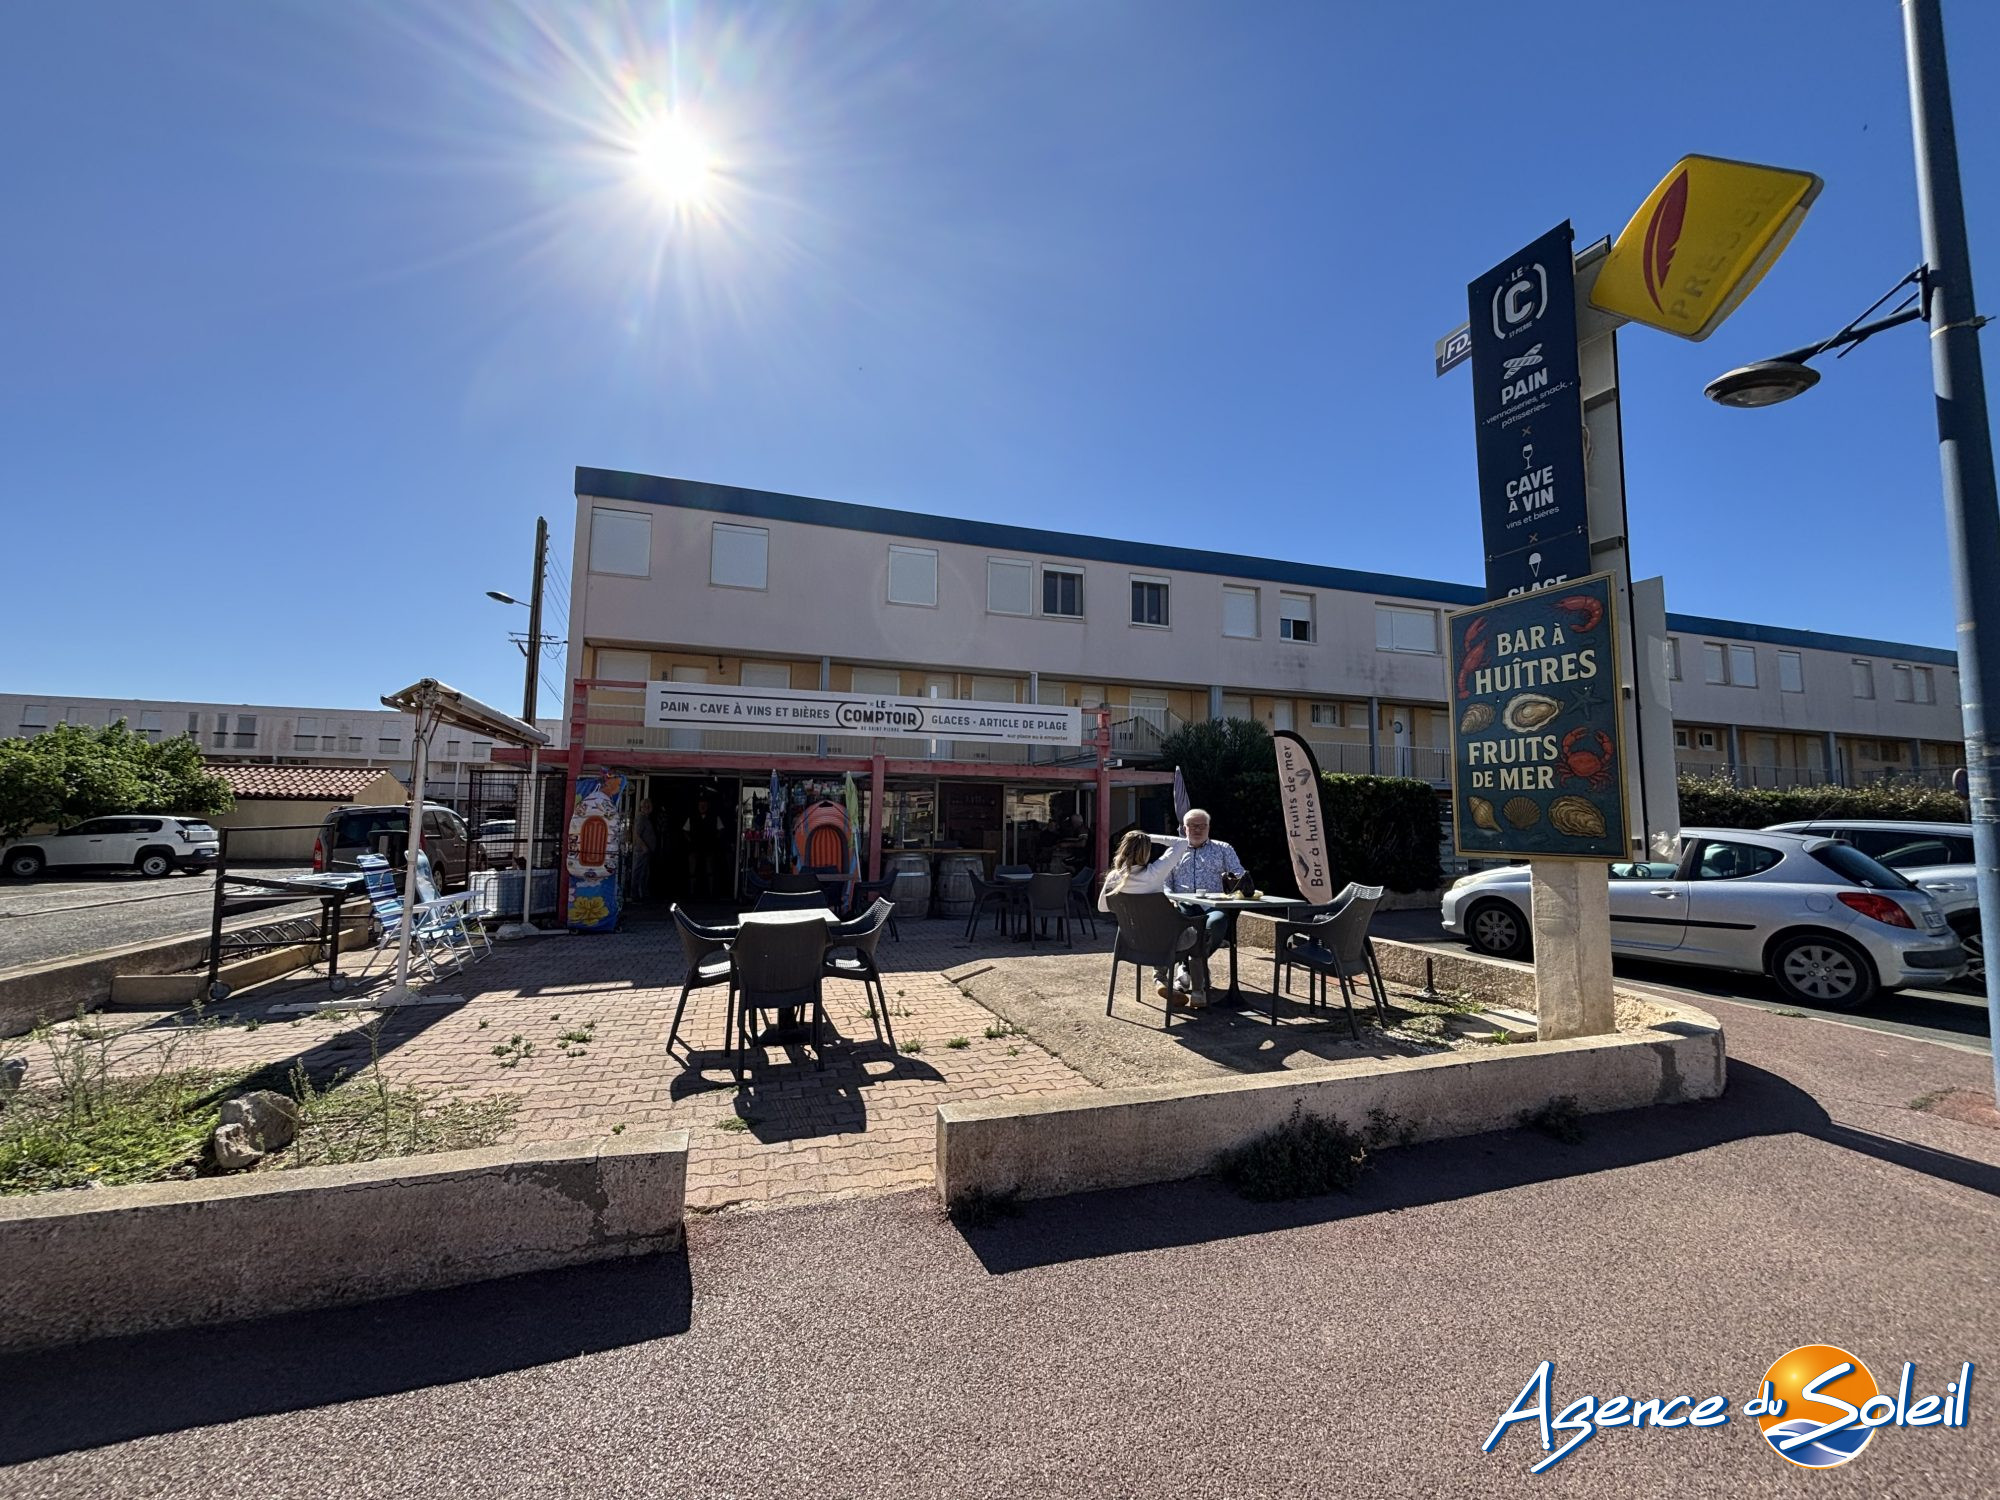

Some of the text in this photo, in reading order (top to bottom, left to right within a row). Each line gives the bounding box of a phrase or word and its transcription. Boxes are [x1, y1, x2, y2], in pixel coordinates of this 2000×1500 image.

[1511, 266, 1524, 282] LE
[1446, 333, 1471, 359] FD
[1501, 367, 1548, 405] PAIN
[1506, 465, 1554, 498] CAVE
[1508, 486, 1554, 514] À VIN
[1506, 506, 1560, 530] vins et bières
[1497, 623, 1565, 657] BAR À
[1475, 649, 1597, 695] HUÎTRES
[660, 701, 830, 719] PAIN CAVE À VINS ET BIÈRES
[843, 709, 917, 725] COMPTOIR
[876, 700, 886, 709] LE
[932, 715, 1067, 731] GLACES ARTICLE DE PLAGE
[1468, 735, 1558, 765] FRUITS
[1472, 766, 1554, 790] DE MER
[1283, 745, 1301, 838] Fruits de mer
[1305, 792, 1318, 842] huîtres
[1311, 861, 1324, 887] Bar
